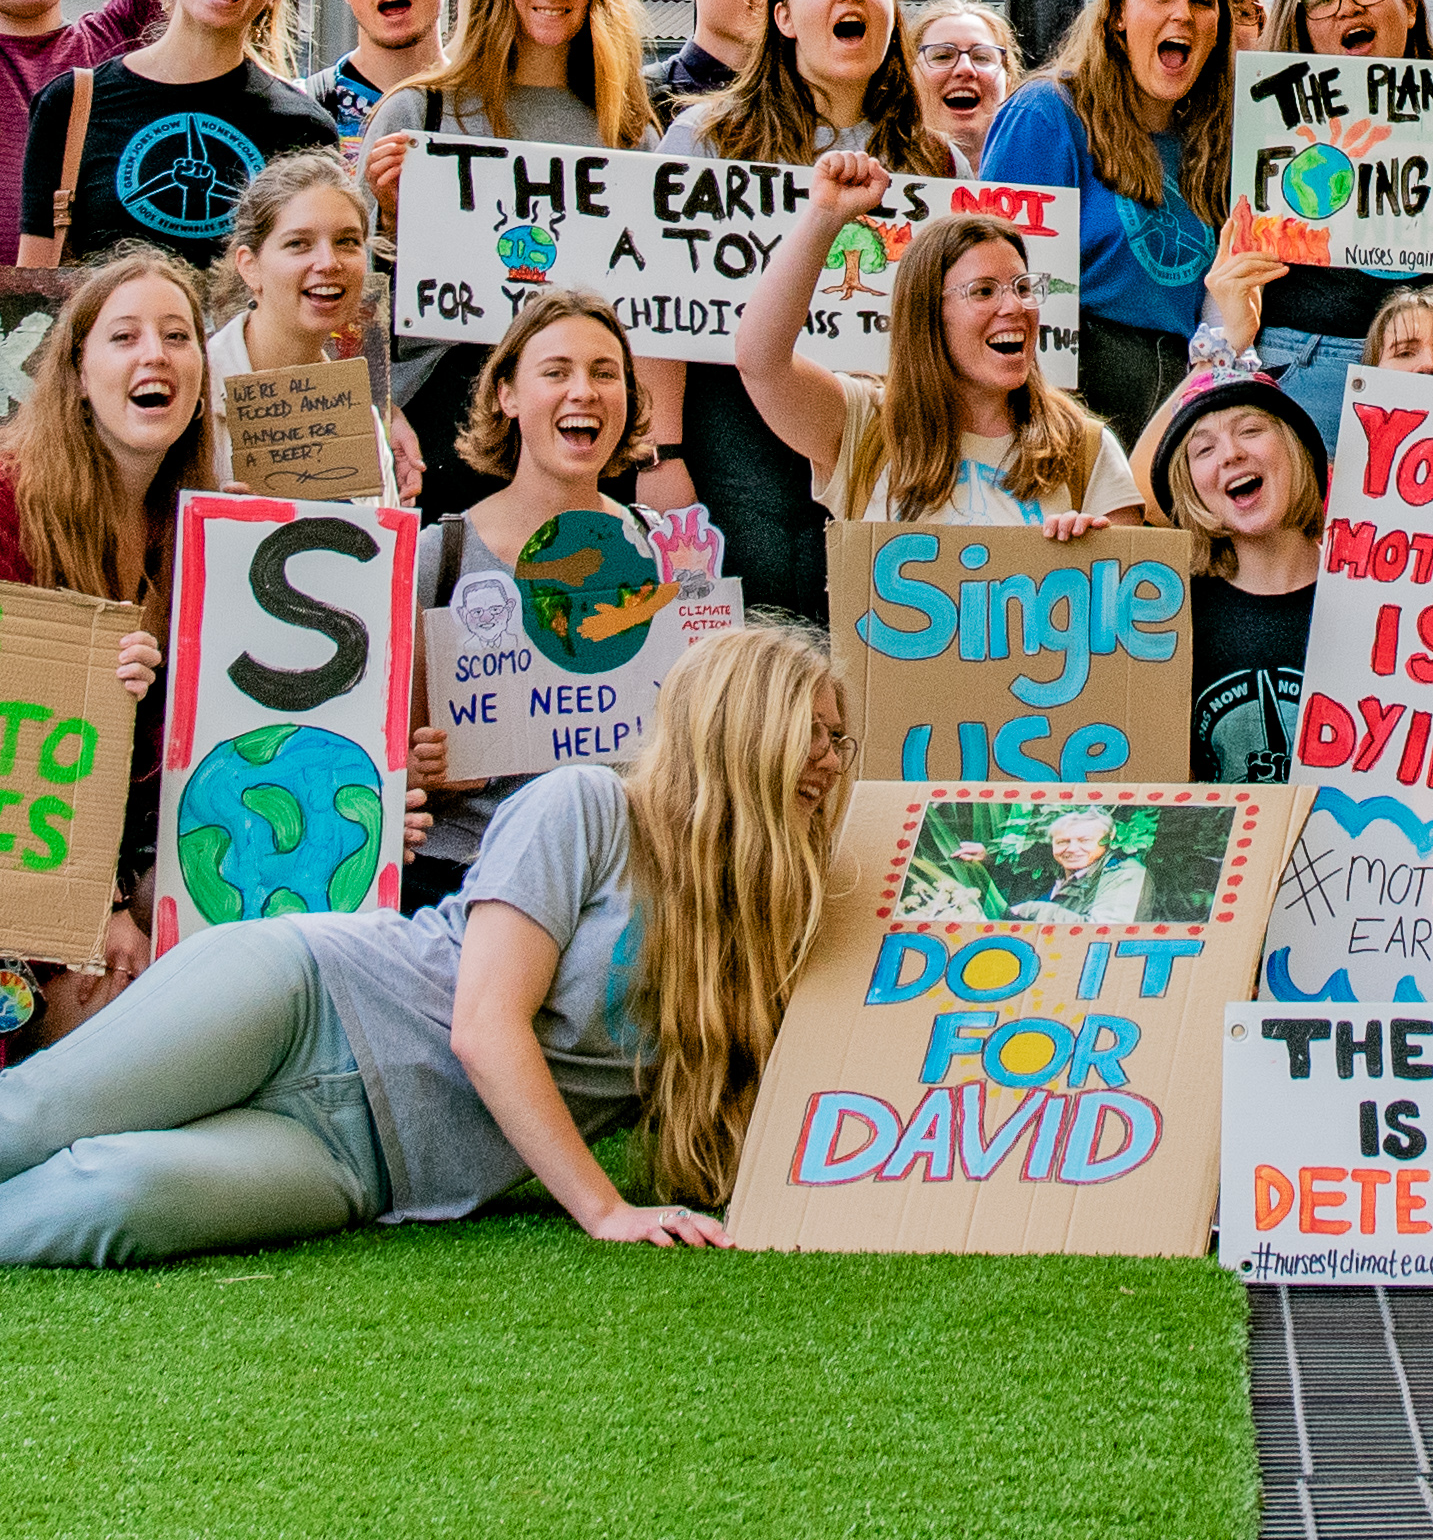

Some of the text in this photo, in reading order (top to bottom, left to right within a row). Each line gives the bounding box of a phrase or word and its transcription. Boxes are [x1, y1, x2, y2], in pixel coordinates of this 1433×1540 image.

[1251, 64, 1348, 131] THE
[123, 121, 180, 189] GREEN JOBS NOW
[202, 121, 261, 164] NO NEW COAL
[427, 138, 610, 220] THE
[951, 186, 1059, 237] NOT
[609, 227, 782, 280] A TOY
[1345, 244, 1394, 266] Nurses
[417, 278, 485, 325] FOR
[233, 378, 316, 402] WE'RE ALL
[236, 400, 292, 421] FUCKED
[242, 423, 337, 445] ANYONE FOR
[246, 443, 323, 467] A BEER?
[228, 517, 380, 711] S
[679, 605, 731, 617] CLIMATE
[857, 533, 1185, 708] Single
[455, 648, 531, 682] SCOMO
[449, 685, 616, 726] WE NEED
[1209, 680, 1299, 712] NOW NO
[865, 933, 1204, 1004] DO IT
[920, 1011, 1141, 1088] FOR
[787, 1080, 1163, 1185] DAVID
[1359, 1100, 1427, 1159] IS
